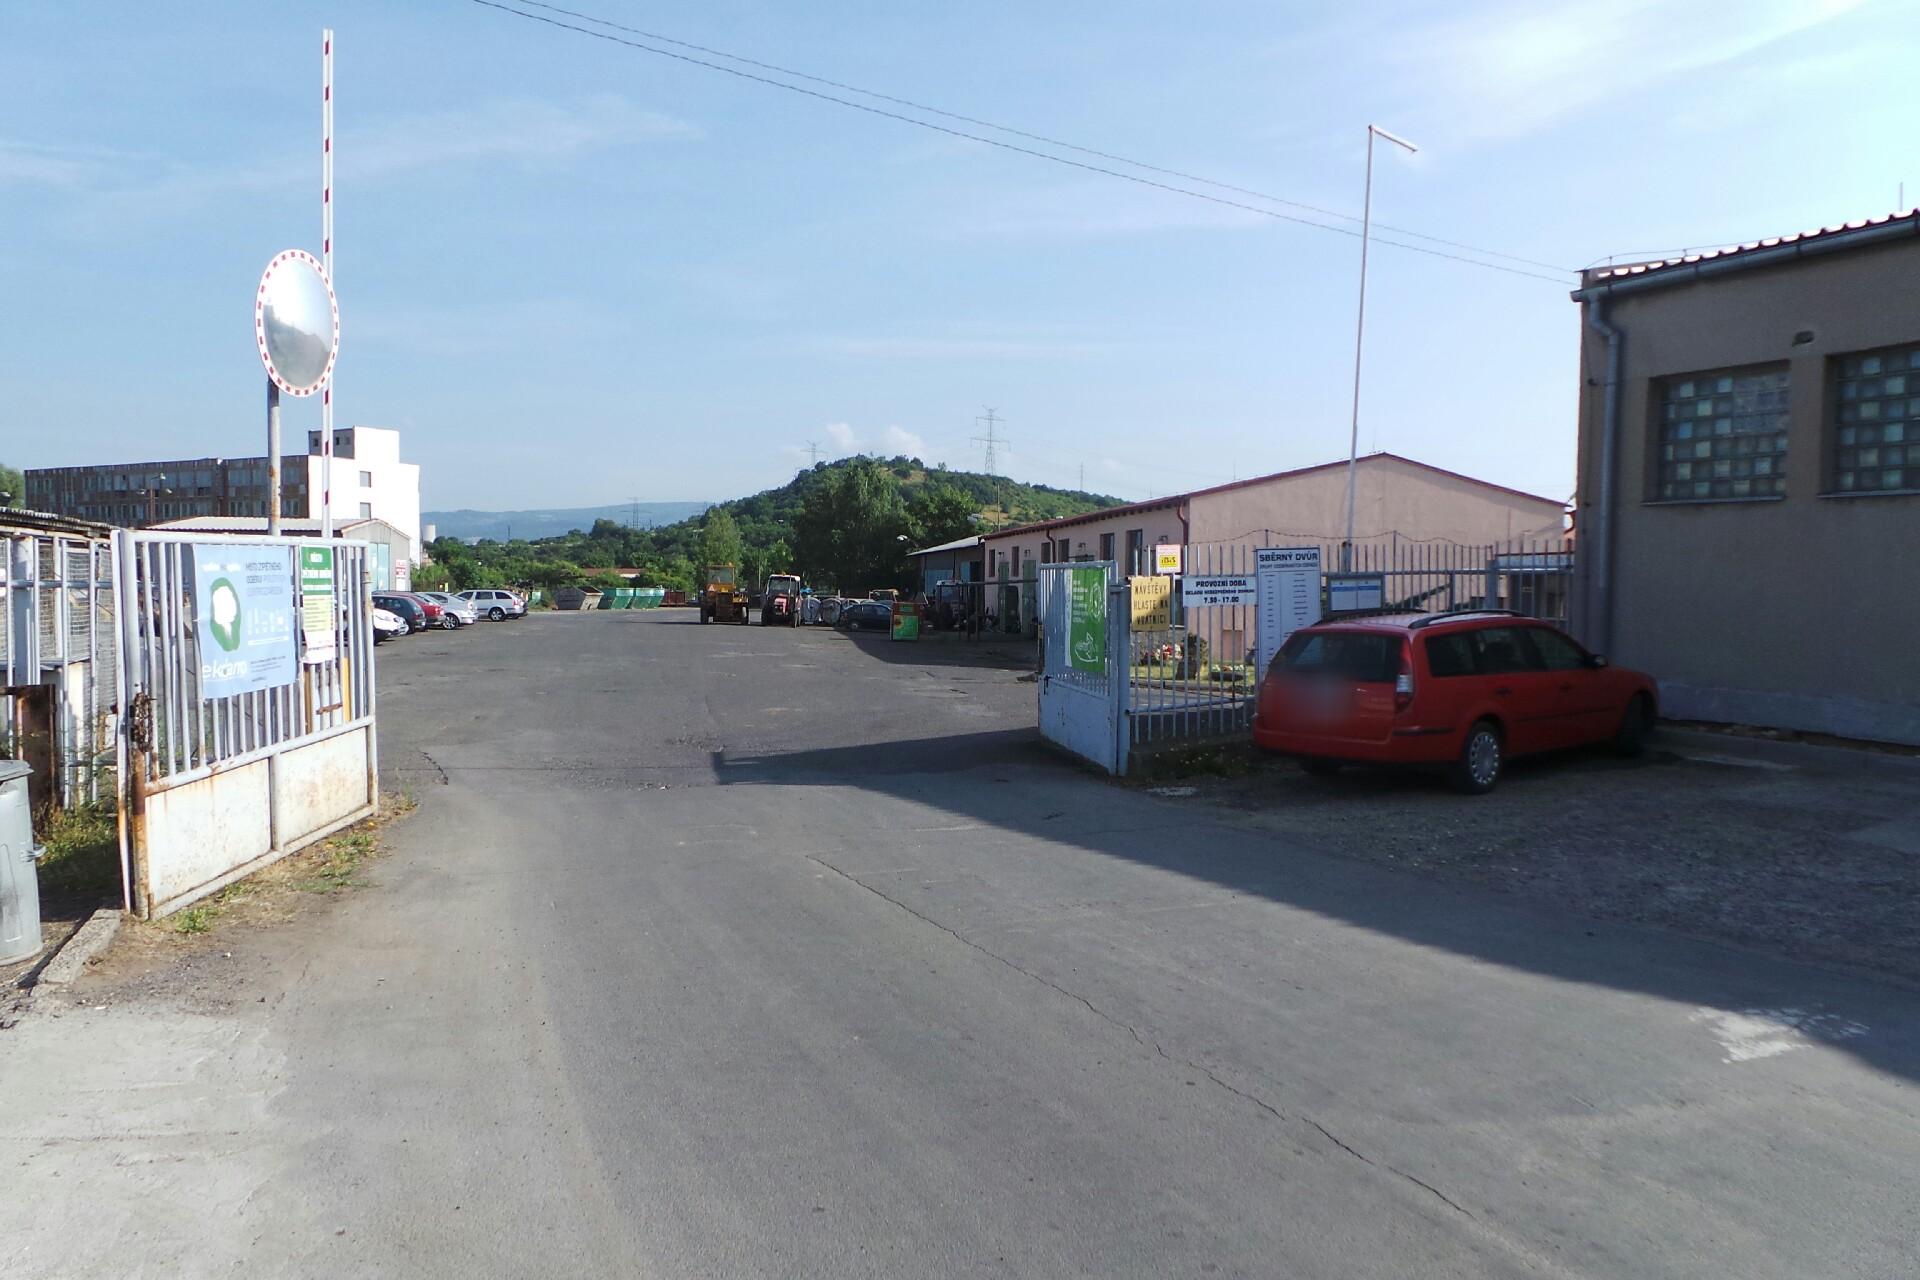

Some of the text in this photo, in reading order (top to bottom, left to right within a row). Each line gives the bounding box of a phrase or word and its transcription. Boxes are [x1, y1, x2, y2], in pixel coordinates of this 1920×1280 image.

[1259, 551, 1318, 561] SBĚRNÝ DVŮR
[1195, 579, 1247, 588] PROVOZNÍ DOBA
[1134, 583, 1167, 595] NÁVŠTĚVY
[1160, 599, 1168, 609] NA
